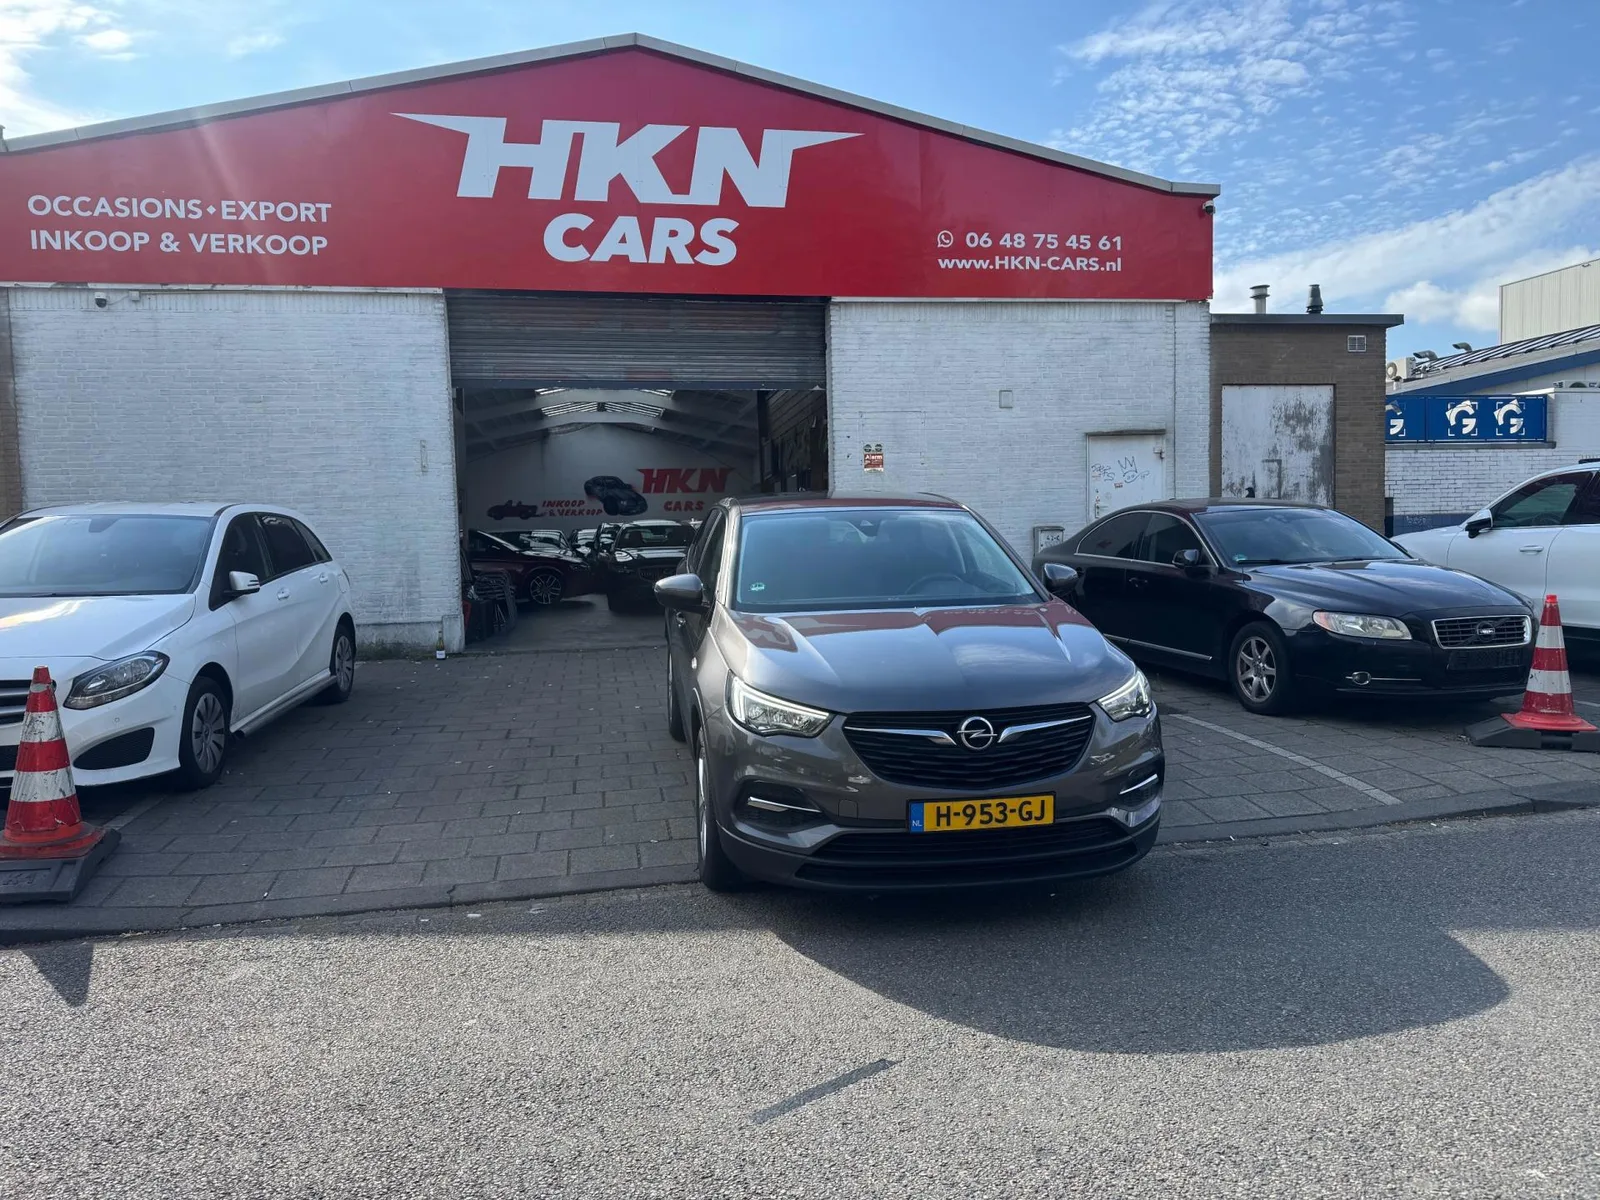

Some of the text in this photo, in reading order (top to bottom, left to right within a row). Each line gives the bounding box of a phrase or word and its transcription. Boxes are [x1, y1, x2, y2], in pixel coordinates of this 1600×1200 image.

[388, 112, 866, 208] HKN
[27, 194, 332, 223] OCCASIONS EXPORT
[30, 229, 328, 255] INKOOP & VERKOOP
[543, 212, 740, 266] CARS
[965, 232, 1122, 251] 06 48 75 45 61
[937, 255, 1122, 272] www.HKN-CARS.nl
[637, 468, 736, 494] HKN
[542, 500, 586, 509] INKOOP
[556, 508, 603, 517] VERKOOP
[663, 501, 705, 512] CARS
[936, 799, 1046, 827] H-953-GJ
